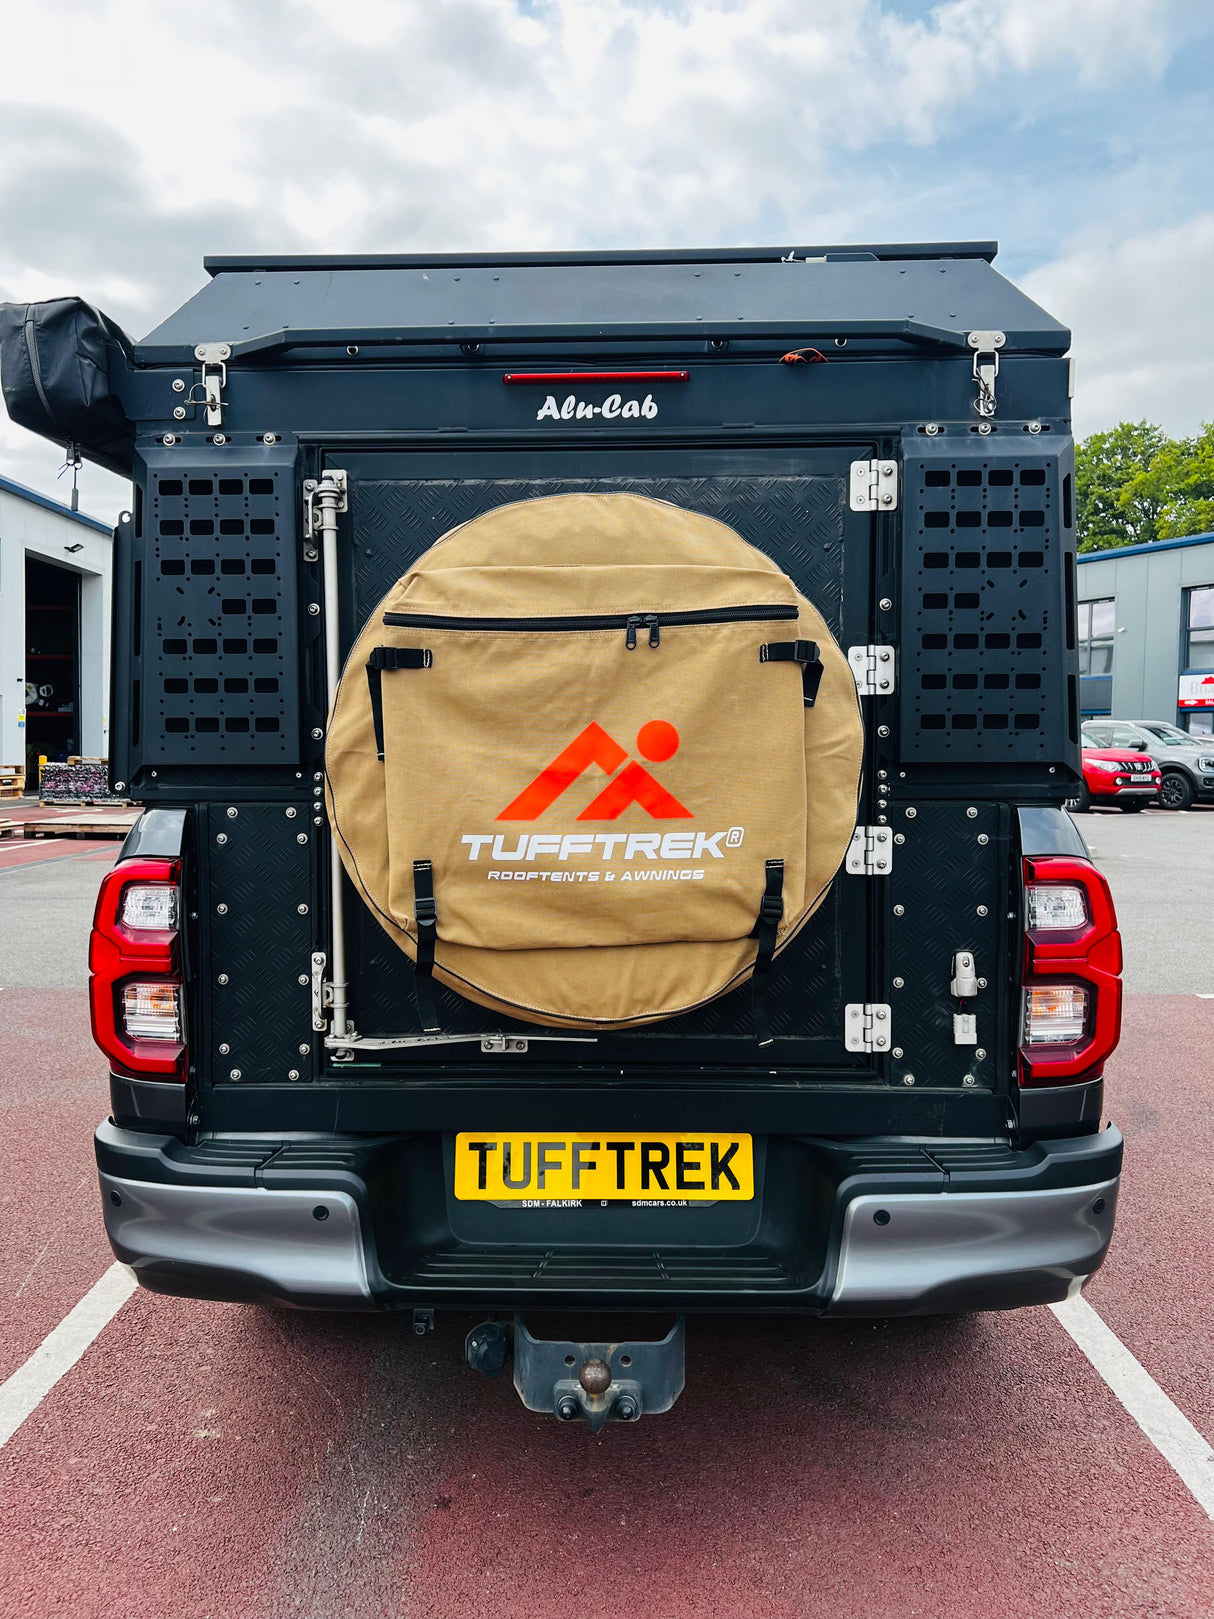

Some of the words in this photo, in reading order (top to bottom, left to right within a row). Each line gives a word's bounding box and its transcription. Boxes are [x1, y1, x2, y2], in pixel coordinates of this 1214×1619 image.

[536, 394, 659, 421] Alu-Cab
[487, 870, 600, 882] ROOFTENTS
[604, 871, 616, 882] &
[620, 869, 705, 881] AWNINGS
[468, 1141, 741, 1191] TUFFTREK
[521, 1199, 540, 1208] SDM
[546, 1199, 583, 1208] FALKIRK
[631, 1199, 688, 1208] sdmcars.co.uk
